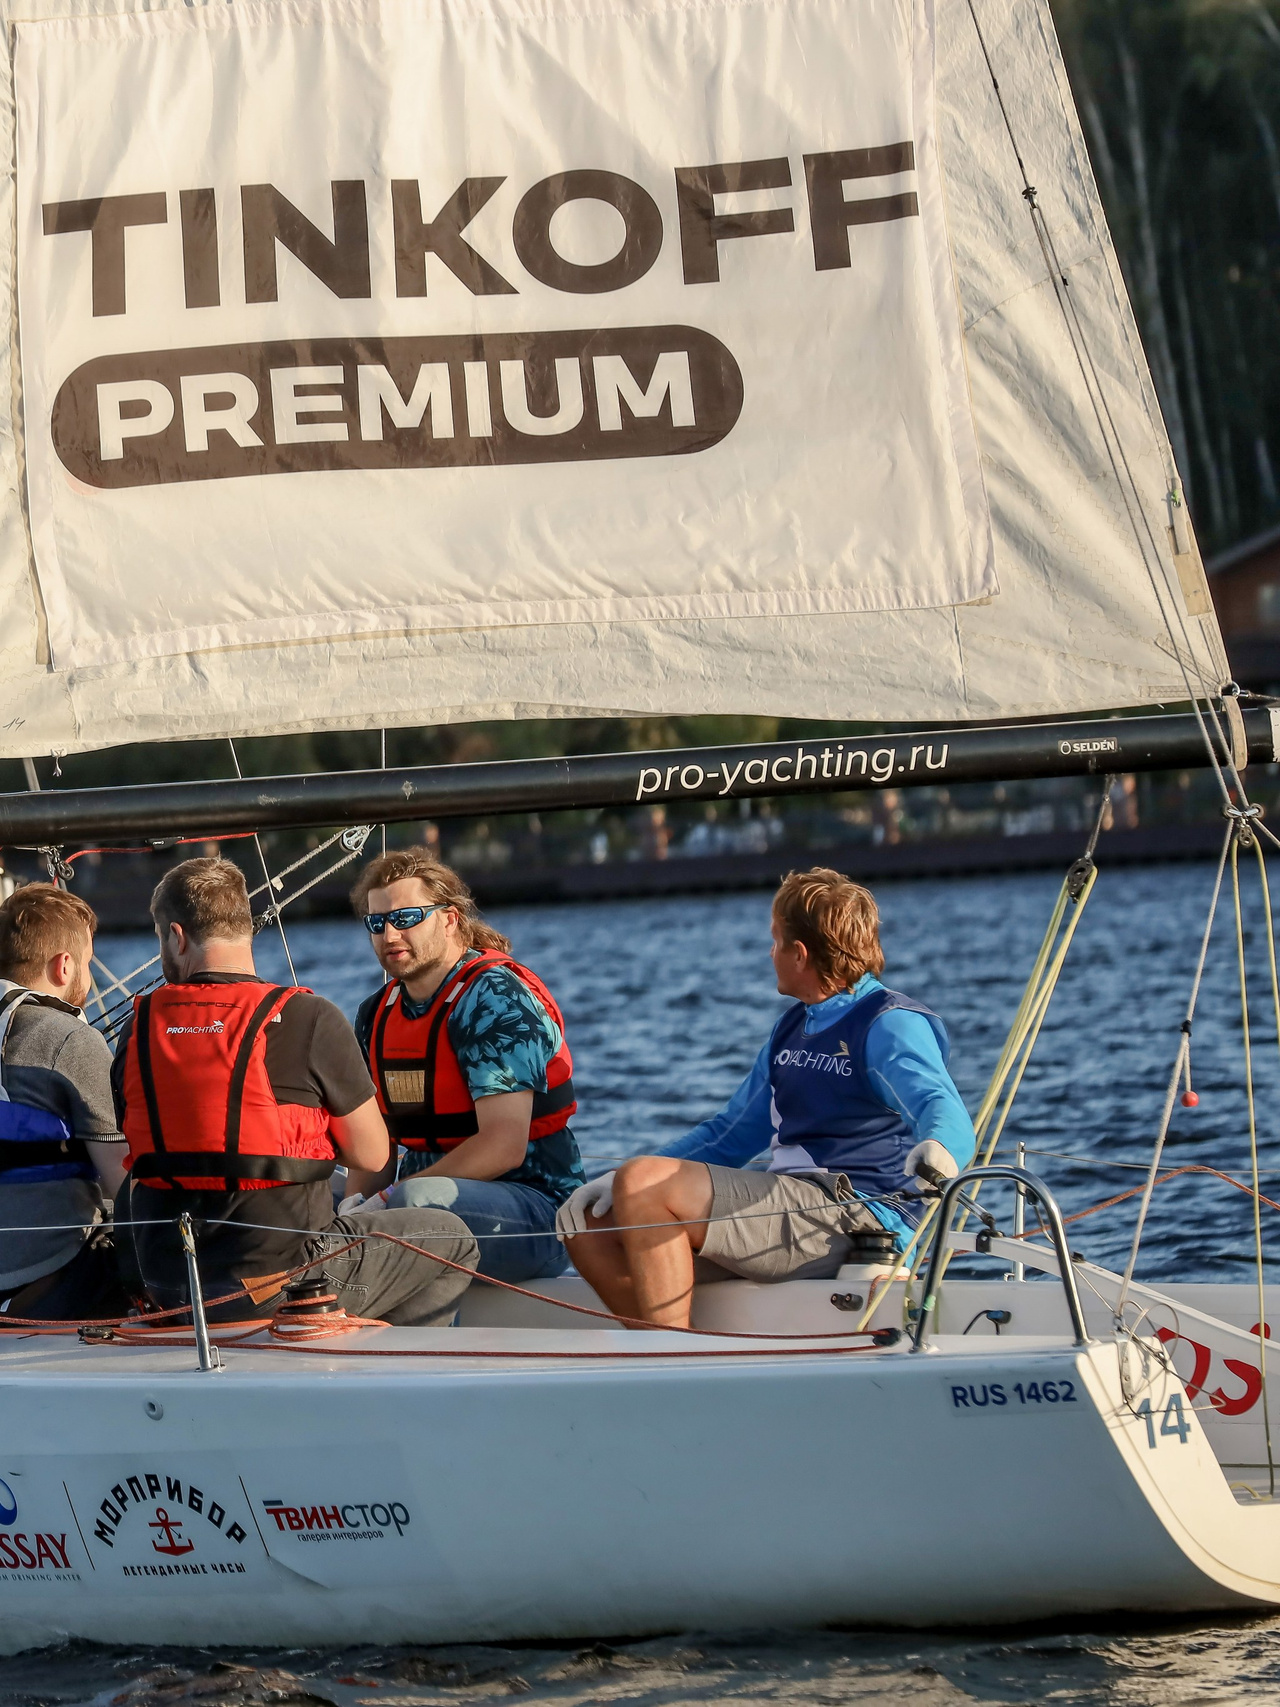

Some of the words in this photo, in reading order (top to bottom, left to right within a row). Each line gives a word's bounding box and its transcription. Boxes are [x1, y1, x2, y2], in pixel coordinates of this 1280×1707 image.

[42, 141, 920, 317] TINKOFF
[95, 351, 697, 461] PREMIUM
[1072, 740, 1115, 753] SELDÉN
[636, 743, 950, 801] pro-yachting.ru
[166, 1025, 224, 1034] PROYACHTING
[951, 1384, 1008, 1408] RUS
[1013, 1380, 1078, 1406] 1462
[1136, 1393, 1191, 1449] 14
[93, 1473, 248, 1548] МОРПРИБОР
[297, 1530, 332, 1544] галерея
[332, 1529, 385, 1542] интерьеров
[11, 1574, 52, 1582] DRINKING
[55, 1574, 82, 1582] WATER
[122, 1562, 209, 1577] ЛЕГЕНДАРНЫЕ
[211, 1561, 246, 1574] ЧАСЫ
